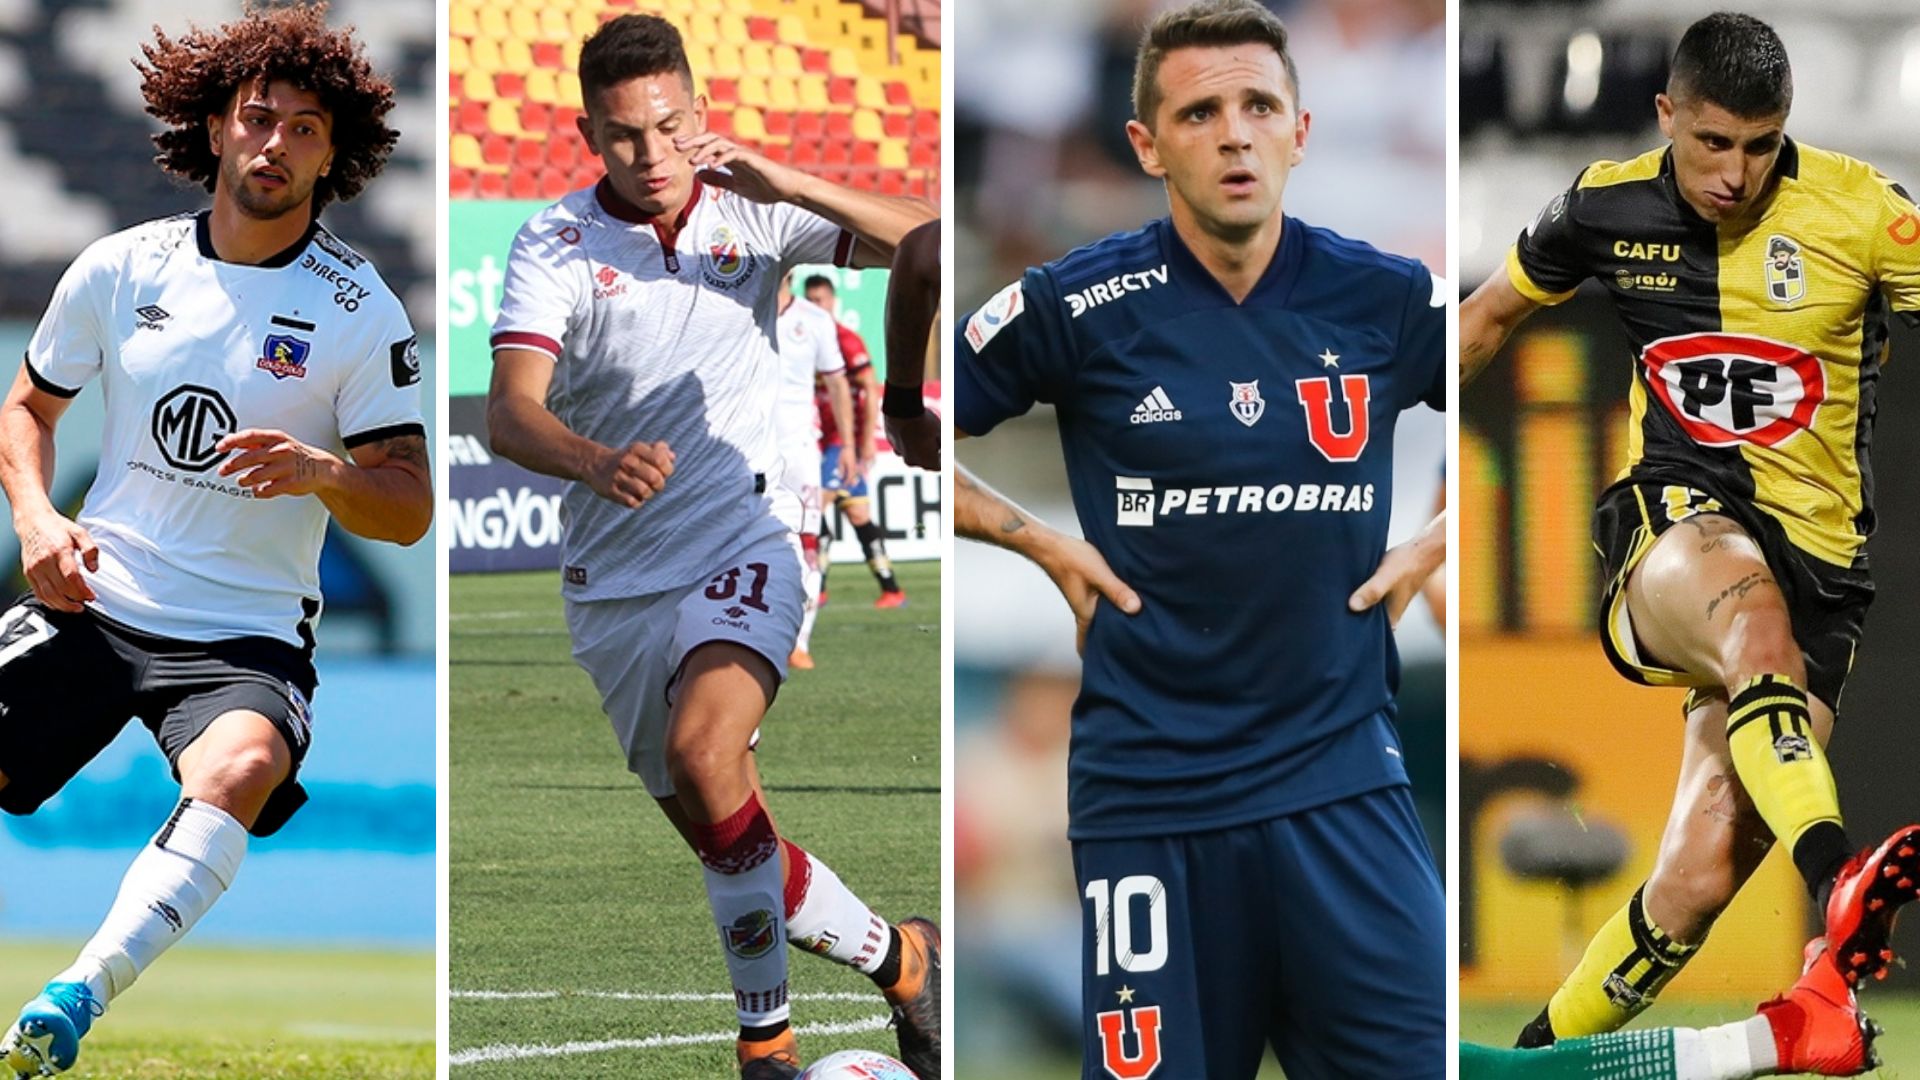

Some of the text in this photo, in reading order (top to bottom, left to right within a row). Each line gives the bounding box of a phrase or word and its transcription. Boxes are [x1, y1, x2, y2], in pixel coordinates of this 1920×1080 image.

[1613, 240, 1681, 262] CAFU
[301, 254, 371, 300] DIRECTV
[1063, 264, 1168, 319] DIRECTV
[334, 291, 359, 313] GO
[1130, 408, 1183, 425] adidas
[1675, 358, 1778, 431] PF
[161, 395, 226, 462] MG
[1294, 374, 1371, 463] U
[182, 478, 253, 499] GARAGE
[1121, 483, 1375, 515] BR PETROBRAS
[712, 616, 751, 632] Onefit
[1085, 874, 1168, 976] 10
[1096, 1005, 1162, 1080] U
